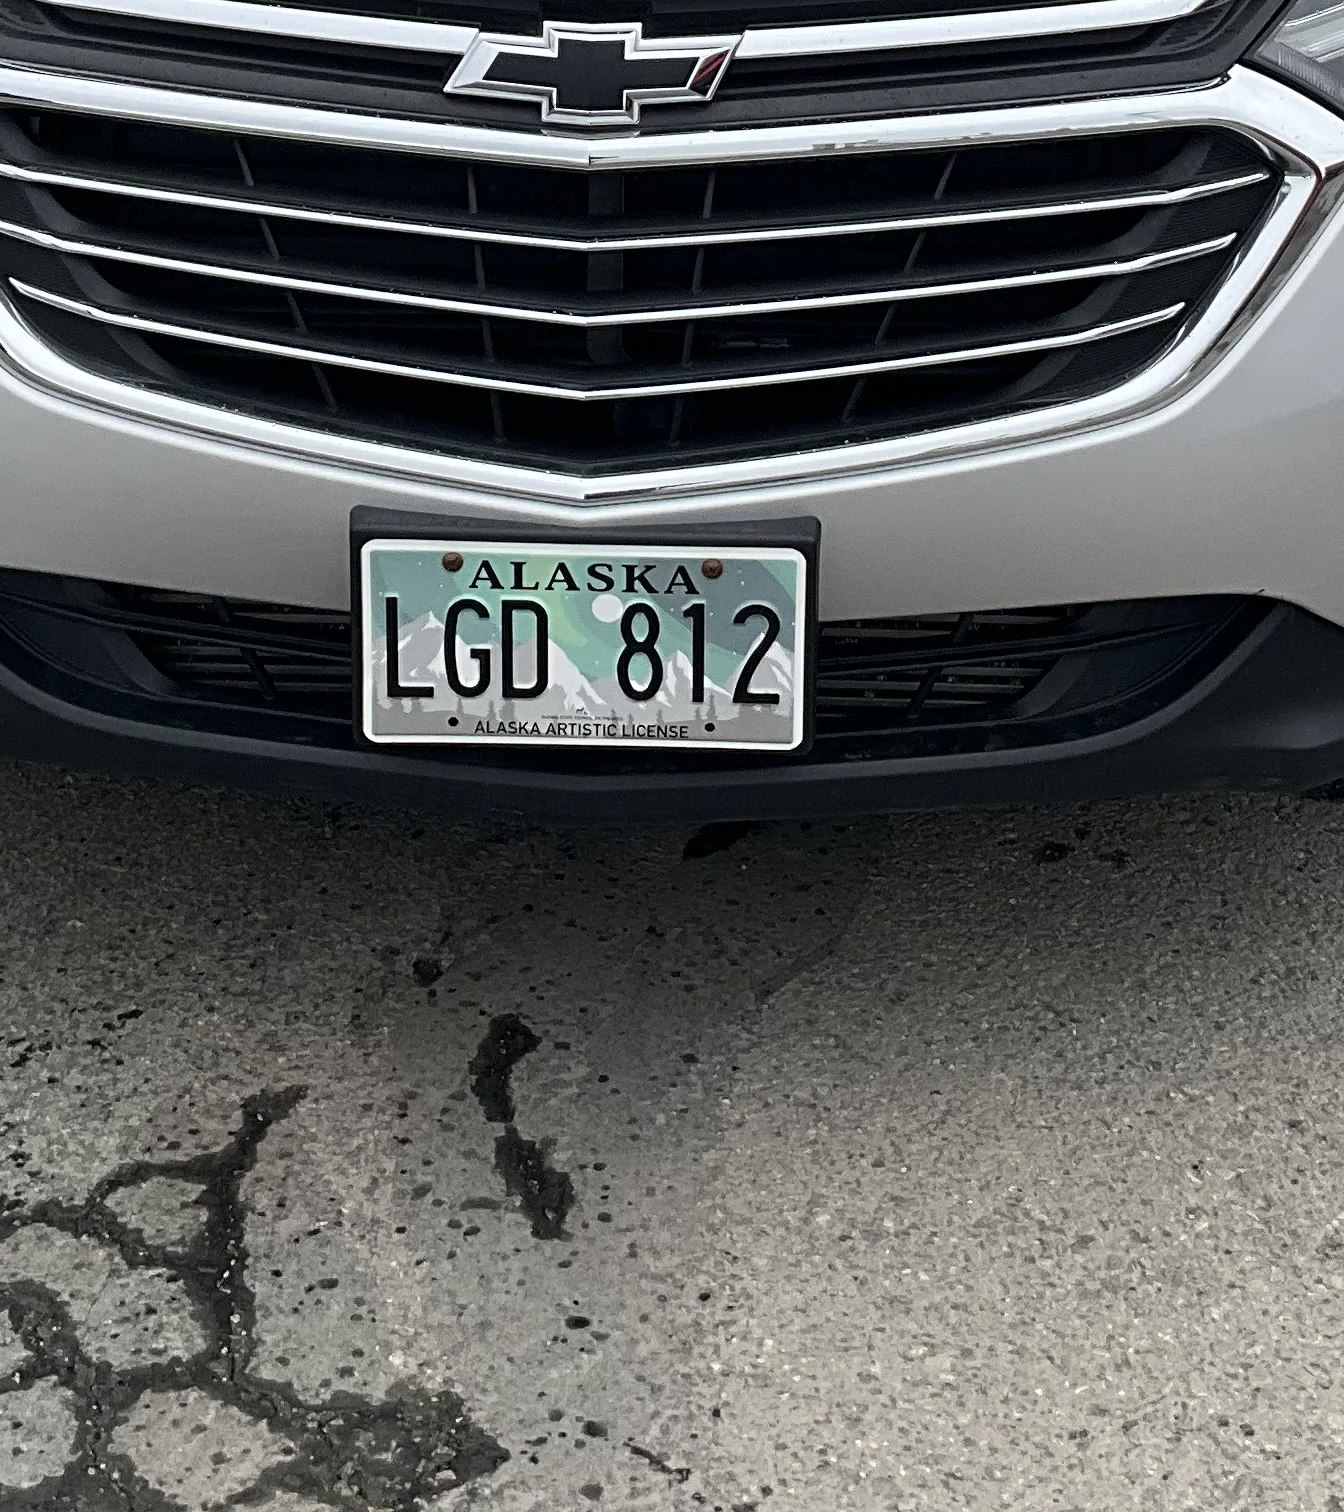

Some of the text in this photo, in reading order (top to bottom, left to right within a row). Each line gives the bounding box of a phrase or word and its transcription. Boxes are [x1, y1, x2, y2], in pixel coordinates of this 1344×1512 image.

[468, 559, 700, 595] ALASKA
[384, 596, 781, 706] LGD 812
[474, 720, 689, 738] ALASKA ARTISTIC LICENSE
